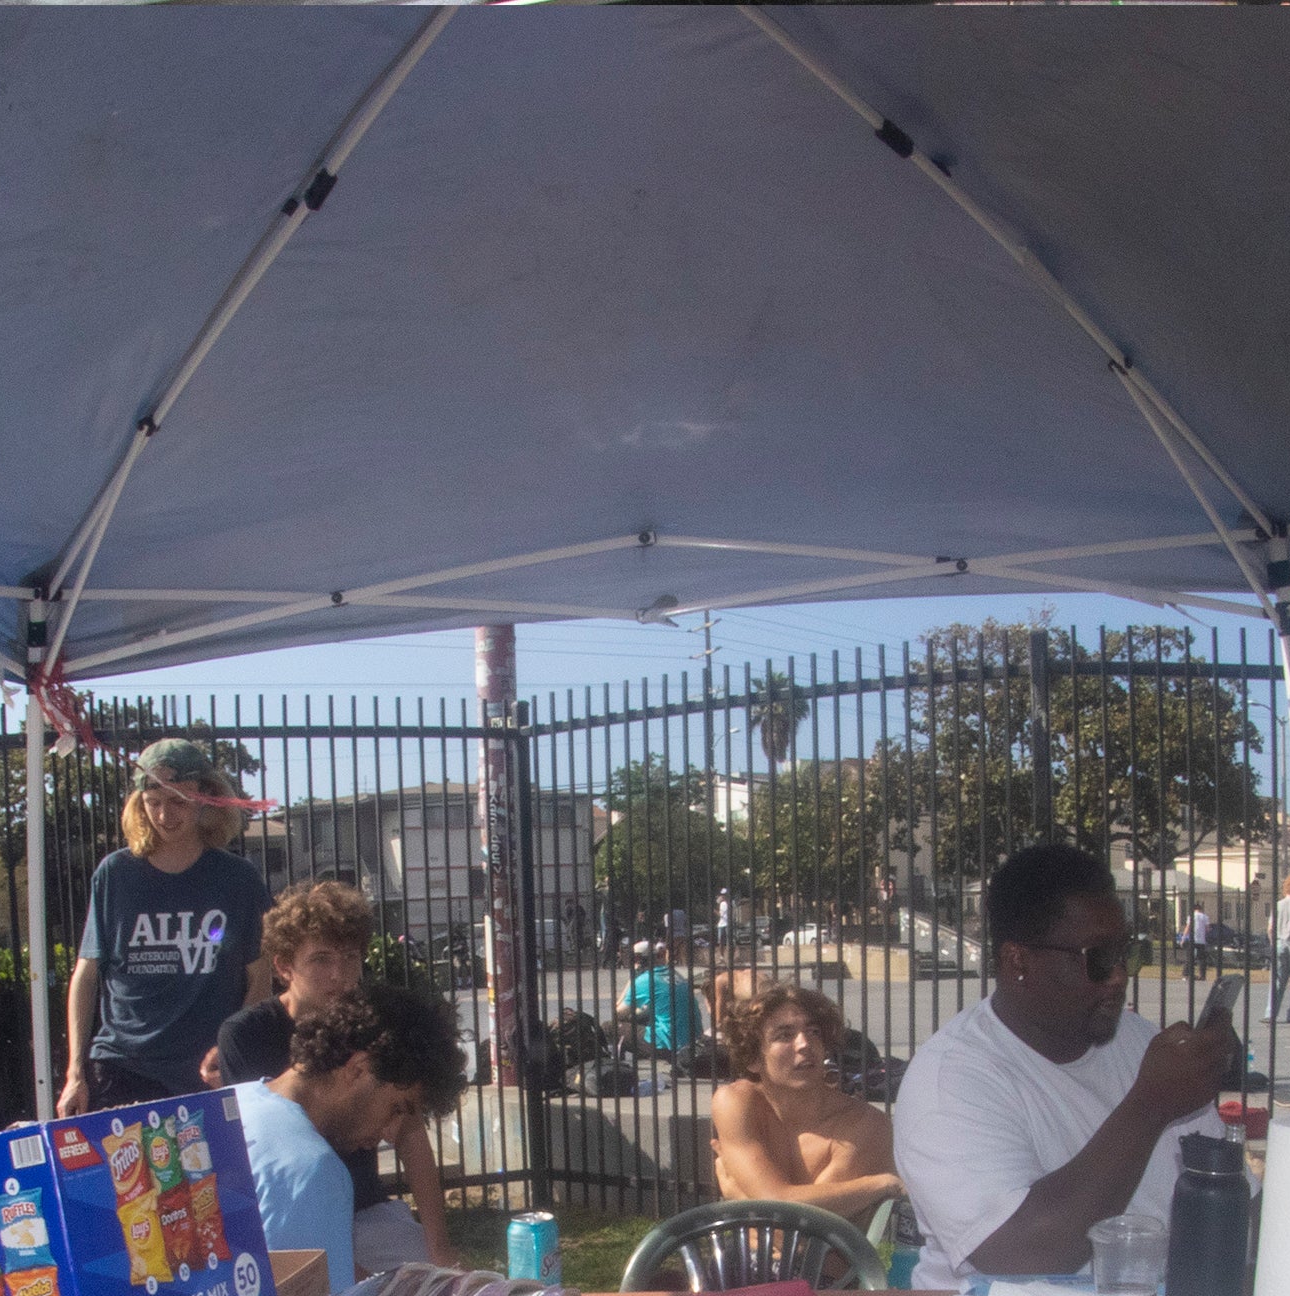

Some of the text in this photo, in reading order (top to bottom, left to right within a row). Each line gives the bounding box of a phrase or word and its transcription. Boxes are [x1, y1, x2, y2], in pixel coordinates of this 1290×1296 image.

[111, 1141, 139, 1181] Fritos
[1, 1201, 37, 1223] RUFFLES
[236, 1262, 257, 1291] 50
